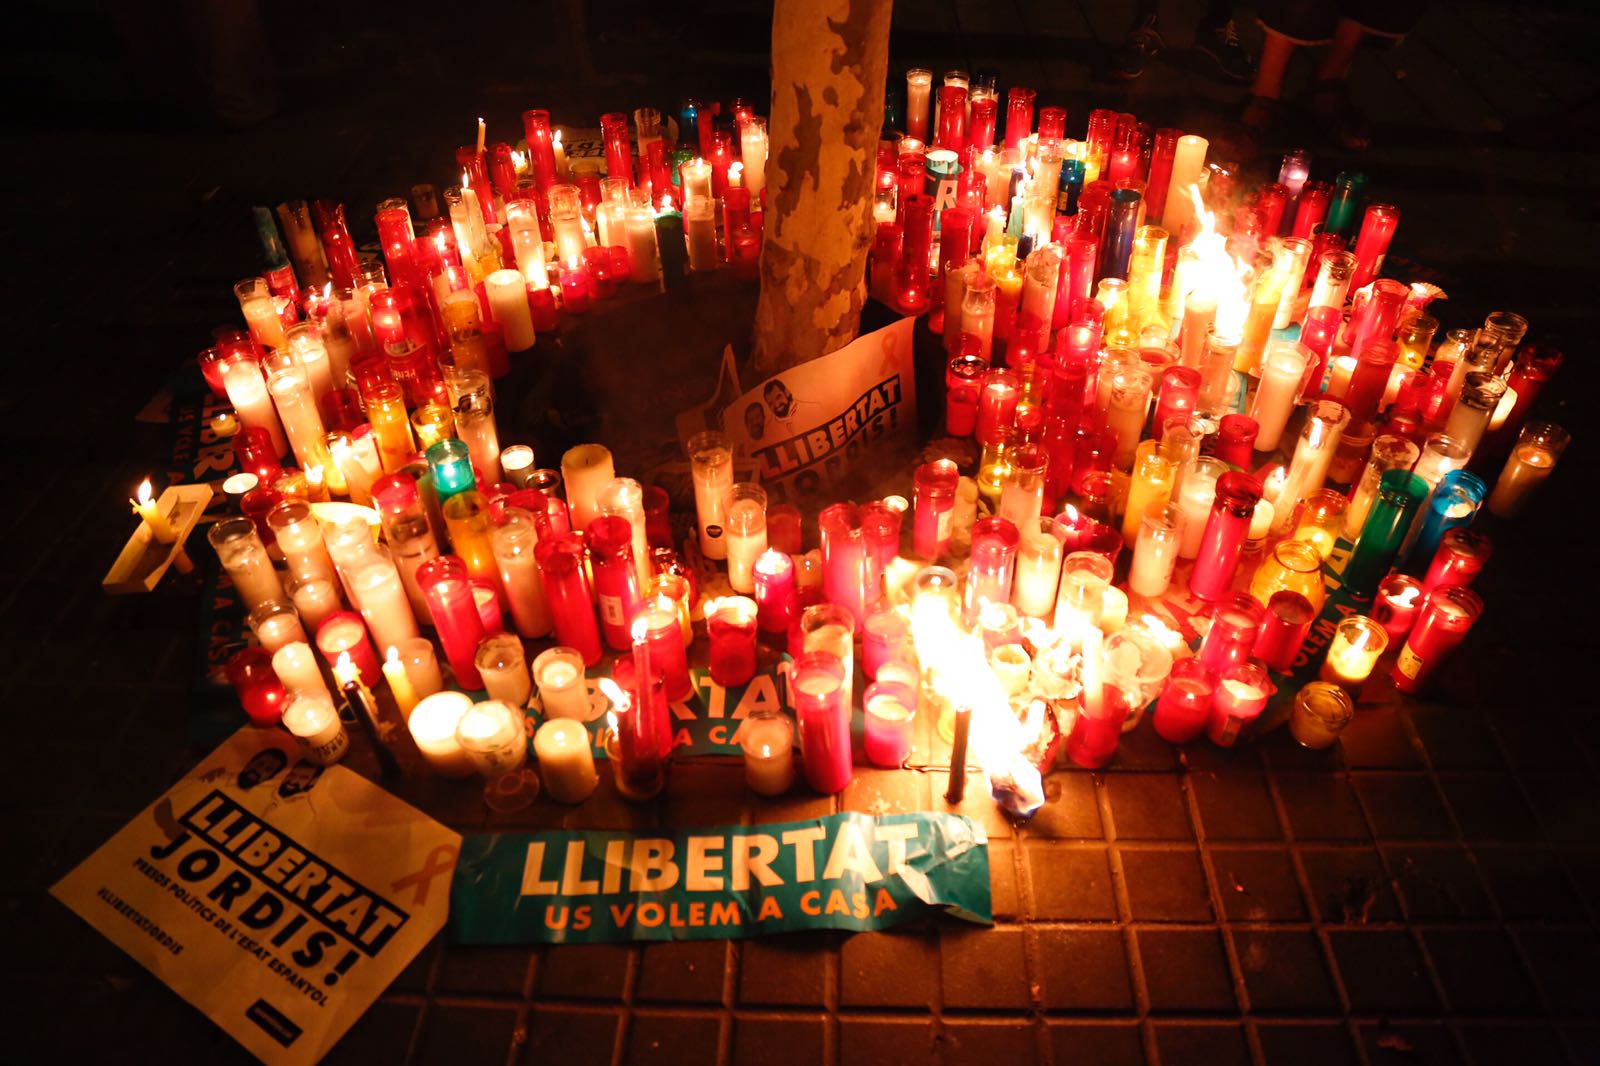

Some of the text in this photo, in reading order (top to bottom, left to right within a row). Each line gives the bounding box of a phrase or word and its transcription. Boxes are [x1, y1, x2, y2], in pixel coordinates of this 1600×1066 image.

[757, 380, 900, 478] LLIBERTAT
[188, 796, 402, 945] LLIBERTAT
[520, 821, 919, 896] LLIBERTAT
[150, 831, 360, 986] JORDIS!
[544, 887, 897, 930] US VOLEM A CASA
[213, 918, 232, 934] DE
[267, 957, 328, 1007] ESPANYOL
